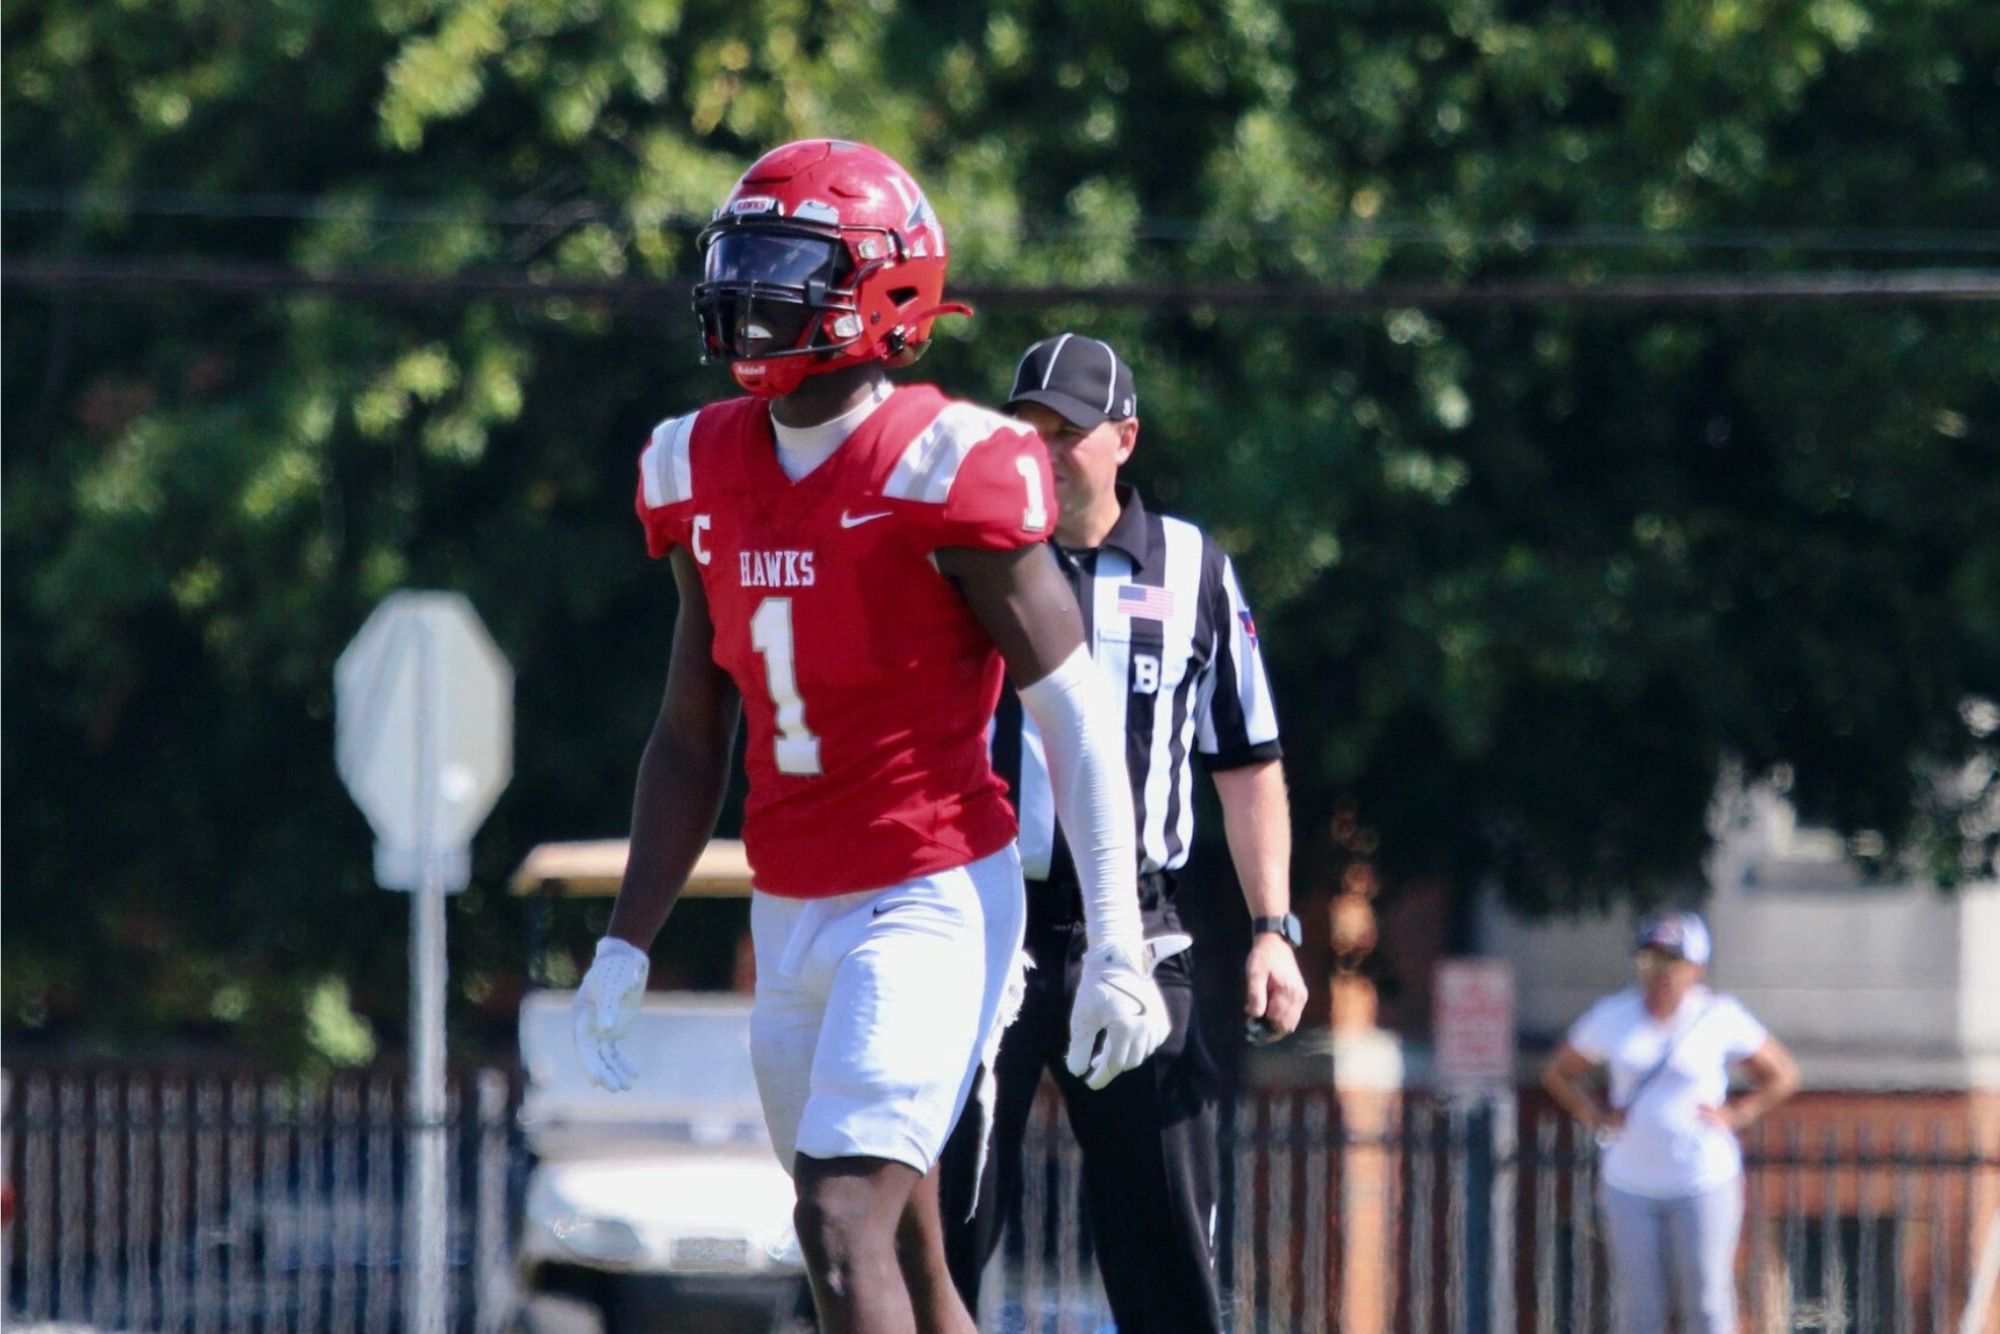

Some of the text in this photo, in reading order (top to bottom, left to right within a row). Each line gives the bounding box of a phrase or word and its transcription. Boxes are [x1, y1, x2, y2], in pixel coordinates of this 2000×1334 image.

[1015, 455, 1047, 533] 1
[692, 514, 711, 566] C
[740, 551, 815, 588] HAWKS
[750, 597, 825, 776] 1
[1133, 654, 1159, 694] B
